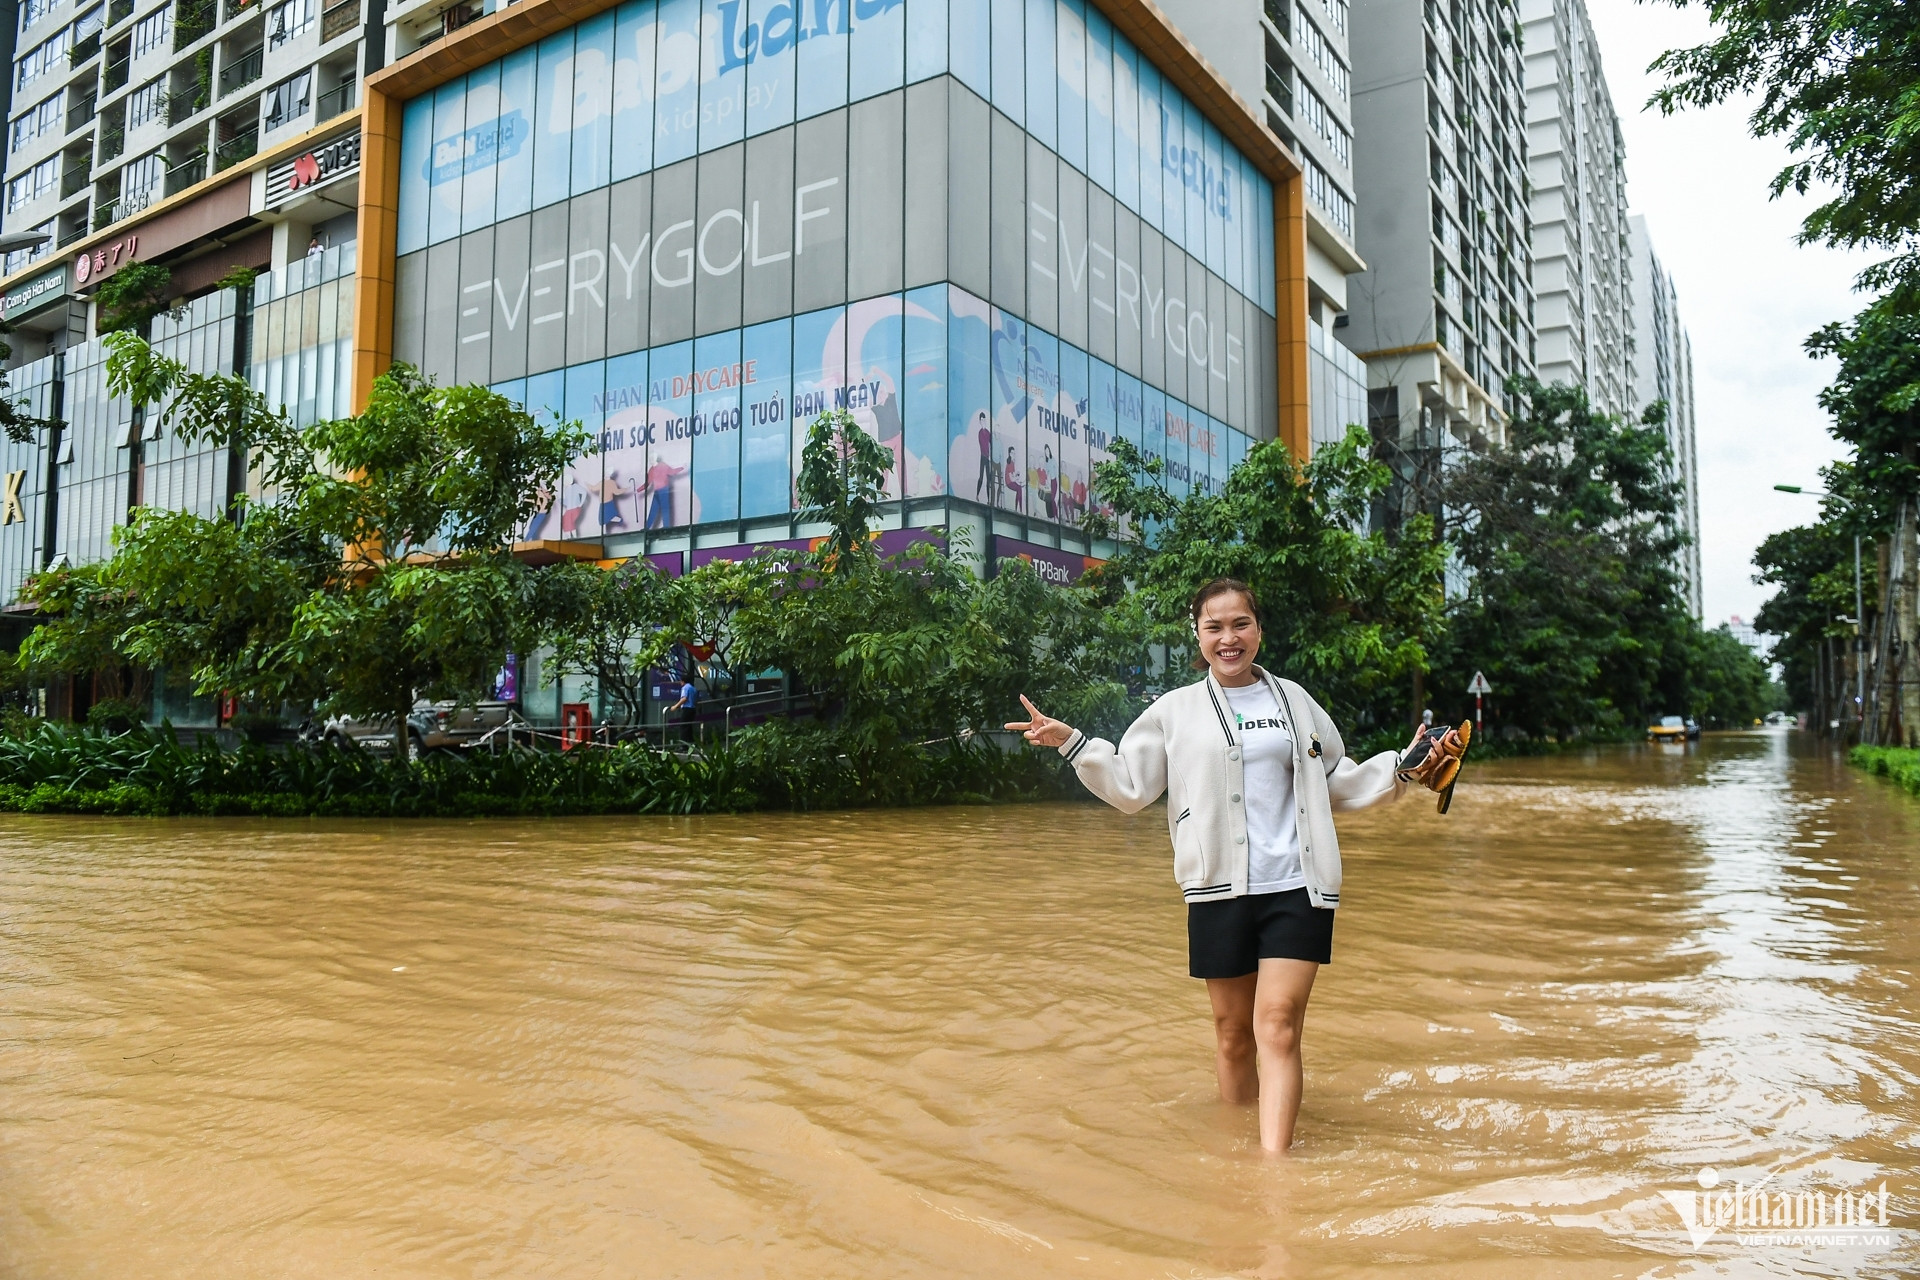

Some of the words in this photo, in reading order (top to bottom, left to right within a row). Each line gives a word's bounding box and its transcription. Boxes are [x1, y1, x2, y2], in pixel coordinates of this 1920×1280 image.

[658, 78, 779, 138] kidsplay
[44, 275, 62, 291] Nam
[462, 177, 839, 344] EVERYGOLF
[1031, 202, 1244, 383] EVERYGOLF
[593, 384, 642, 413] NHAN
[651, 380, 667, 403] AI
[672, 360, 757, 398] DAYCARE
[630, 420, 656, 448] SÓC
[712, 407, 741, 433] CAO
[834, 378, 881, 411] NGÀY
[1037, 405, 1077, 440] TRUNG
[1082, 422, 1107, 452] TÂM
[1166, 411, 1217, 457] DAYCARE
[1032, 558, 1069, 583] TPBank
